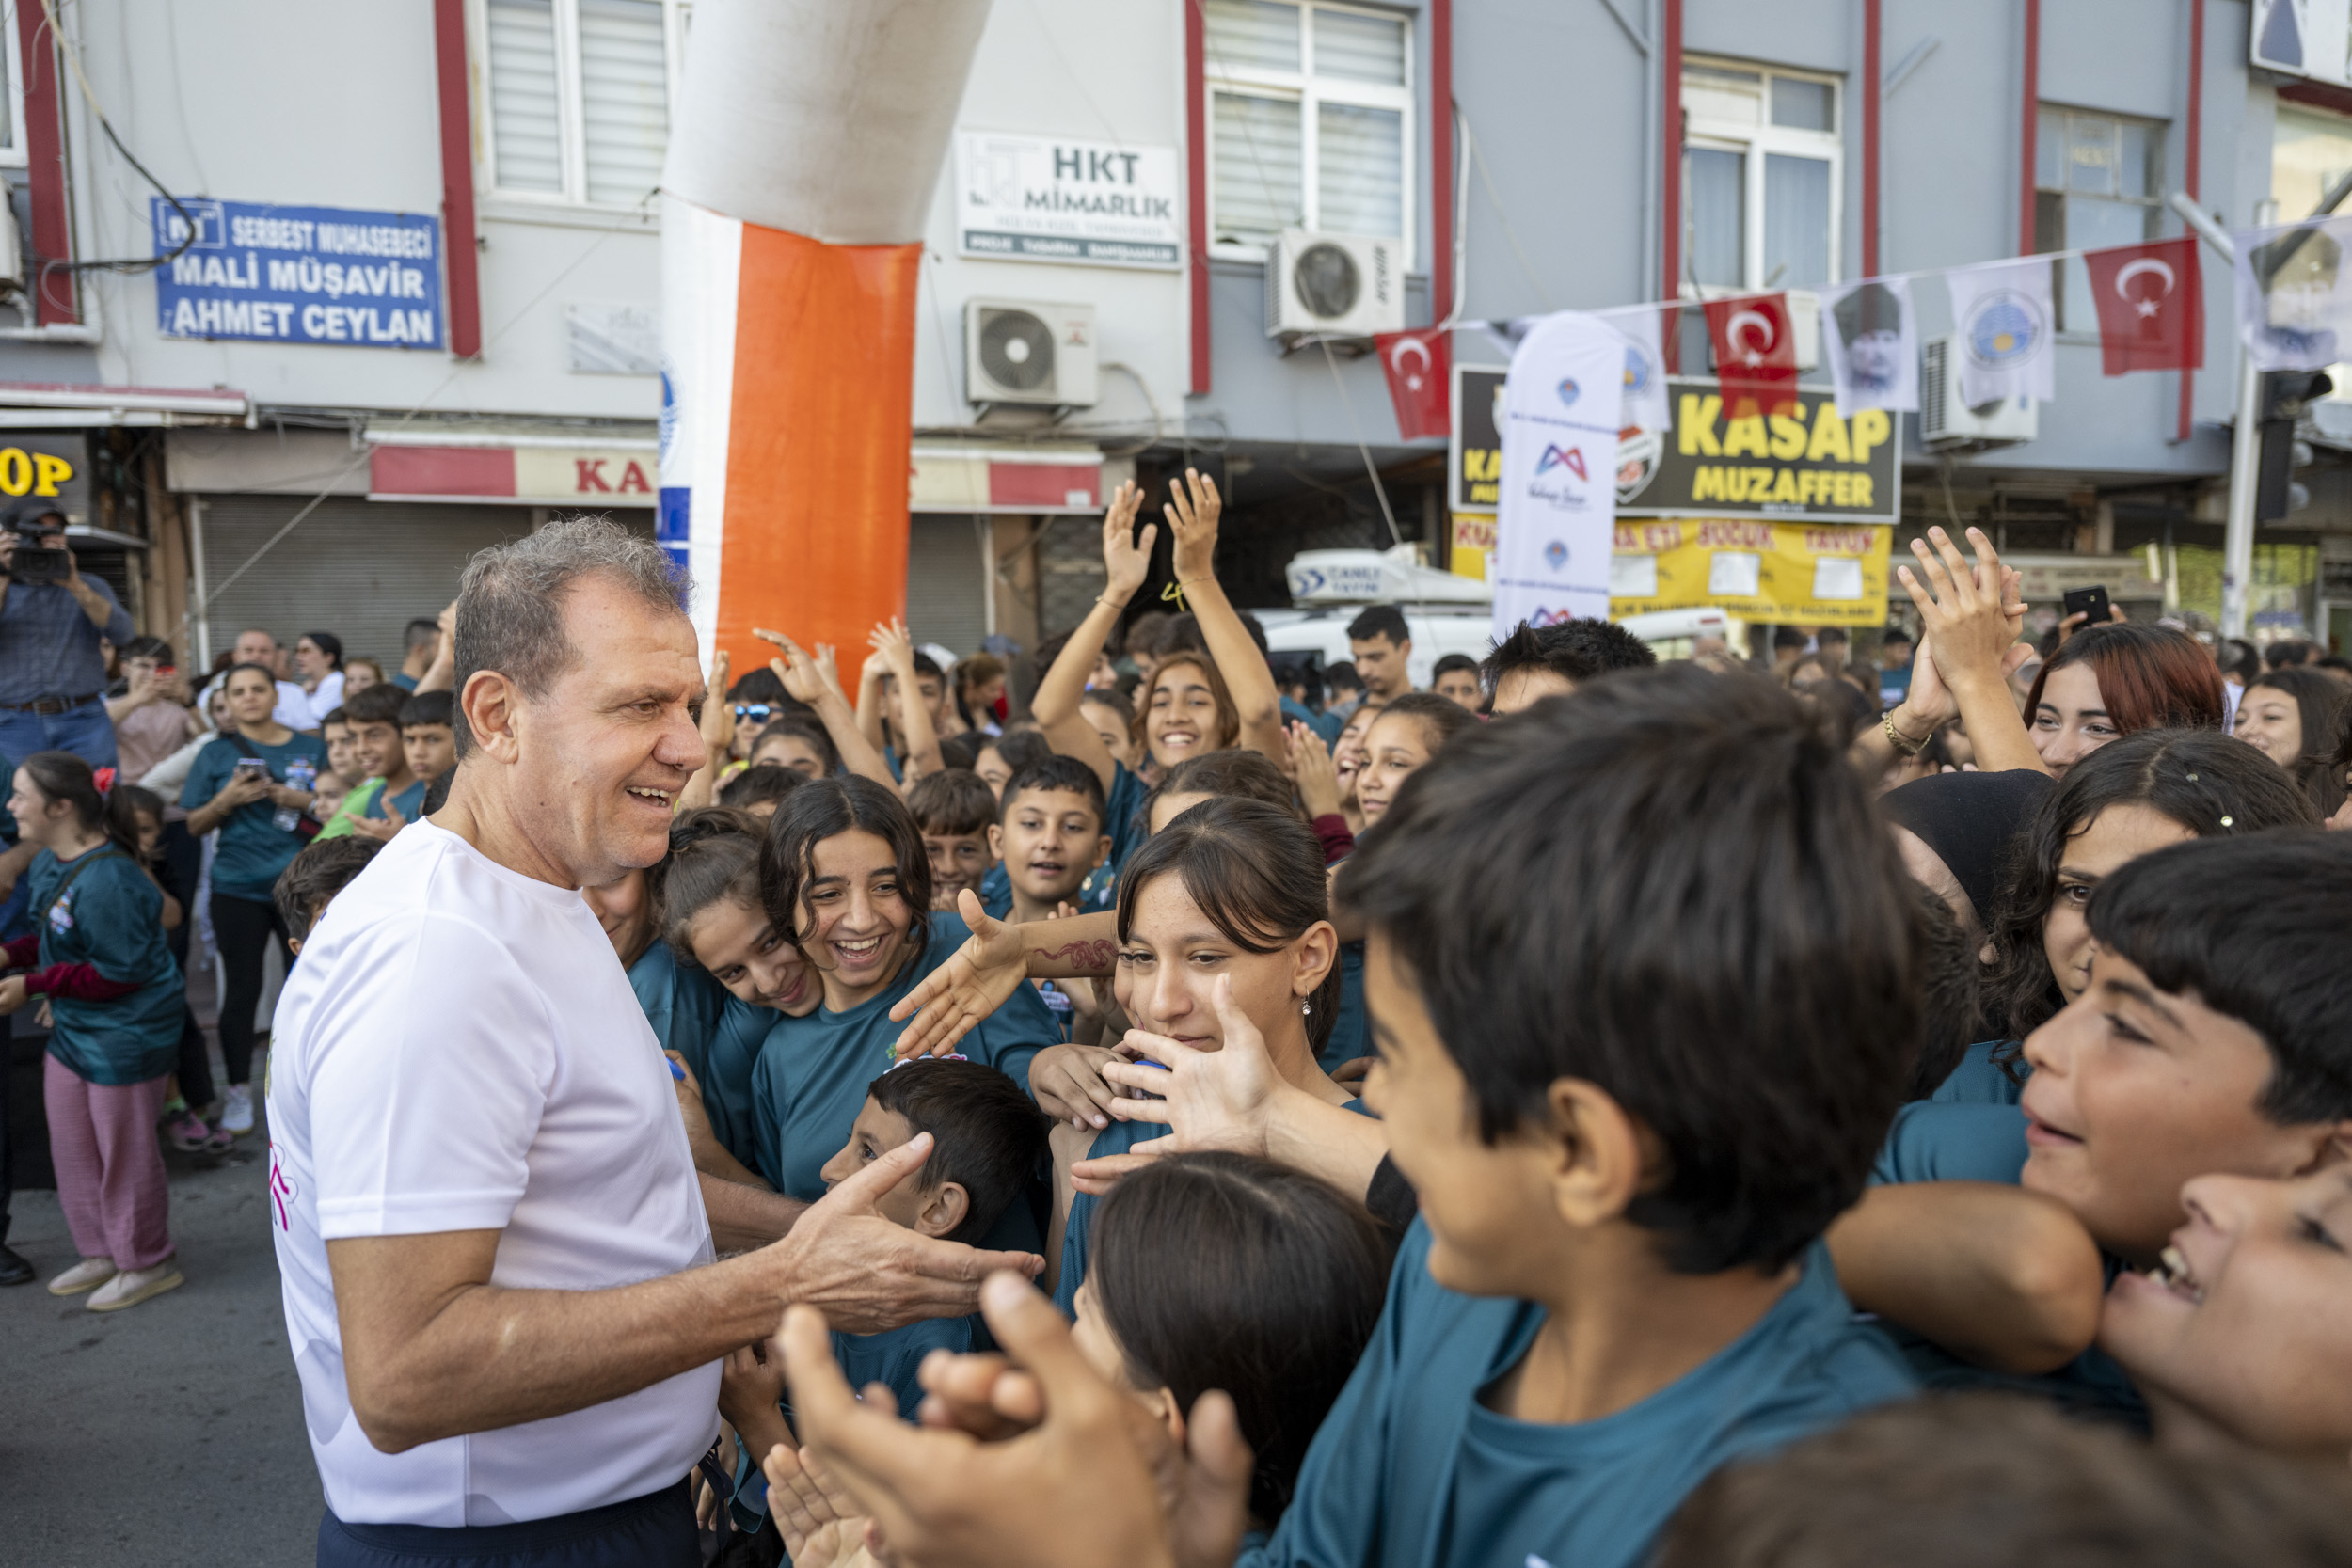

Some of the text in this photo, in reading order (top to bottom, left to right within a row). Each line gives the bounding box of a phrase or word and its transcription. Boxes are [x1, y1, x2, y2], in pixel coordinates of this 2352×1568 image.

[1054, 146, 1140, 185] HKT
[1024, 184, 1171, 220] MİMARLIK
[231, 215, 315, 251] SERBEST
[317, 222, 433, 261] MUHASEBECİ
[173, 250, 425, 300] MALİ MÜŞAVİR
[173, 298, 435, 343] AHMET CEYLAN
[1678, 393, 1891, 464] KASAP
[575, 458, 659, 494] KA
[1464, 448, 1501, 481] KA
[1692, 465, 1874, 508] MUZAFFER
